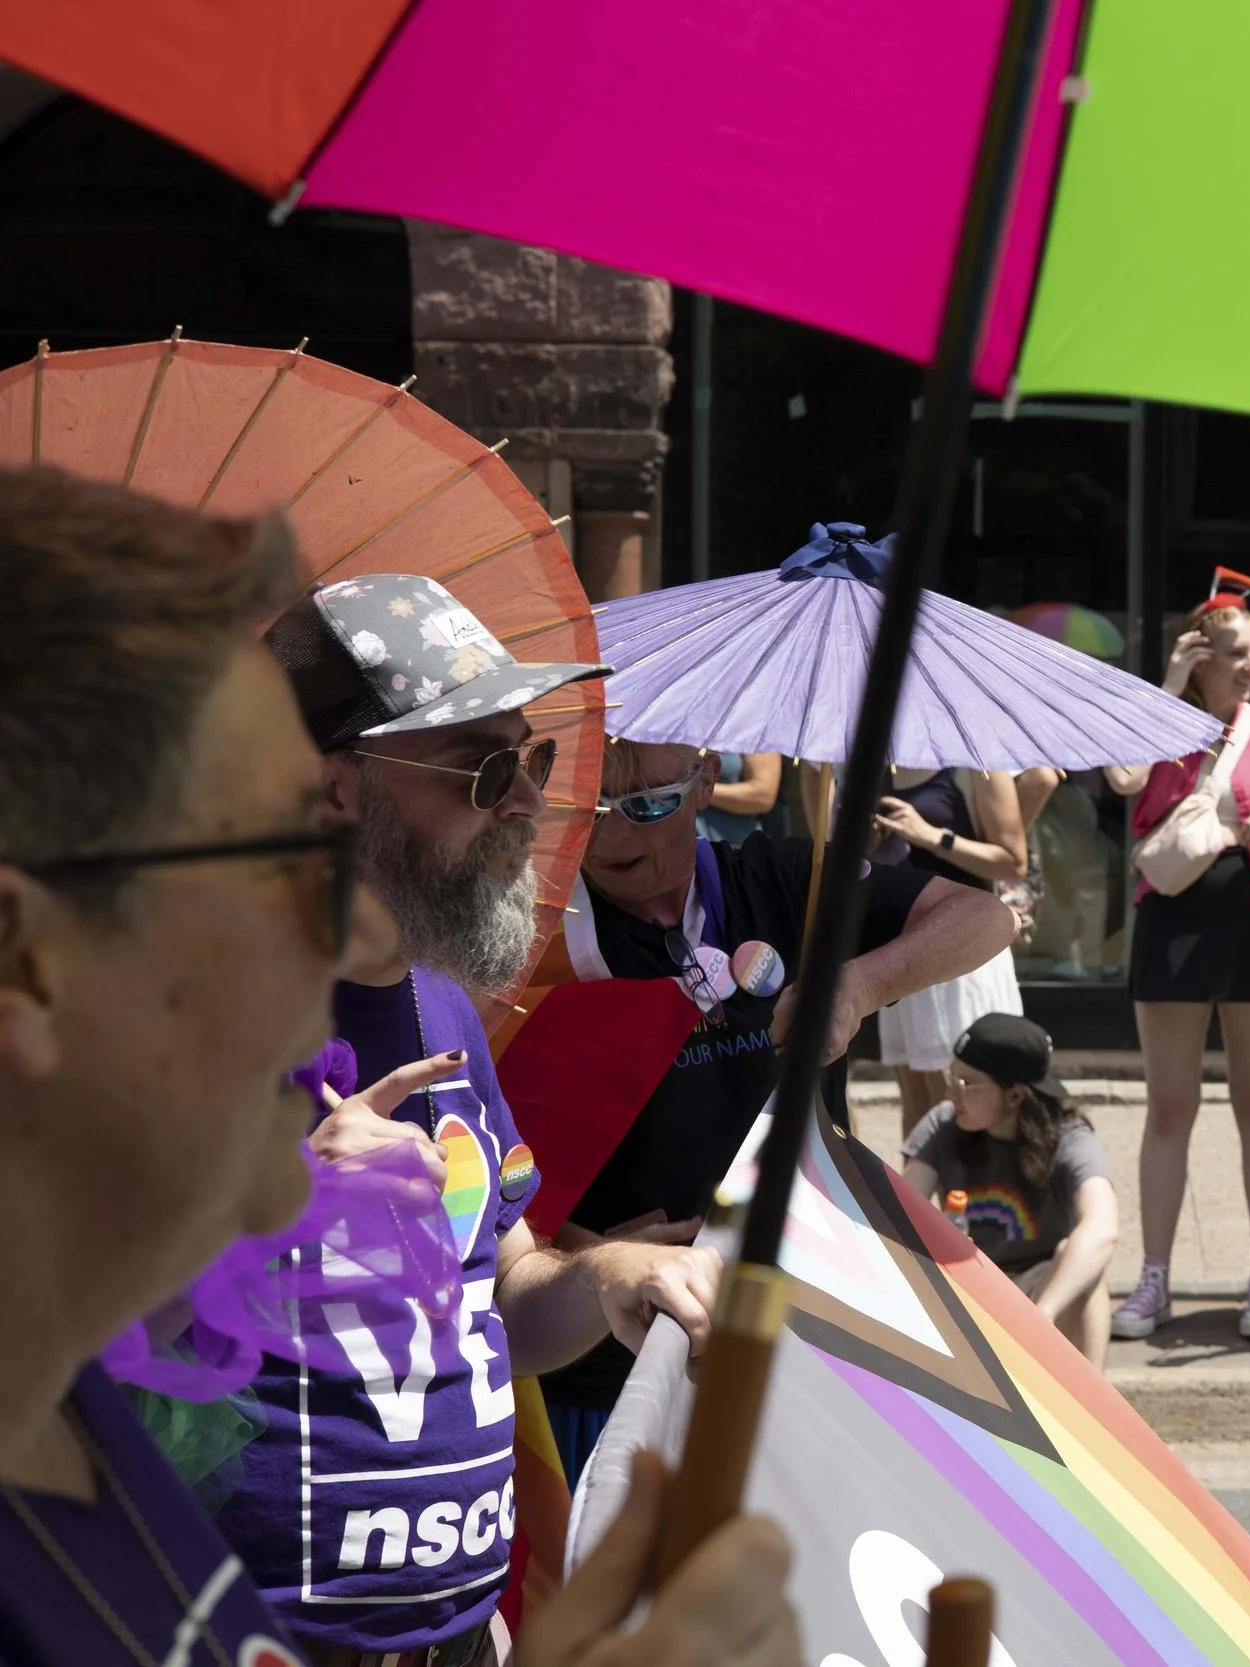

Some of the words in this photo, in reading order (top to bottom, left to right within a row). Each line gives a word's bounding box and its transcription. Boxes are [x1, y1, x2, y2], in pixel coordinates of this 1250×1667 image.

[744, 946, 774, 990] nscc
[716, 1029, 772, 1060] NAM
[506, 1164, 533, 1182] nscc
[320, 1277, 516, 1442] VE
